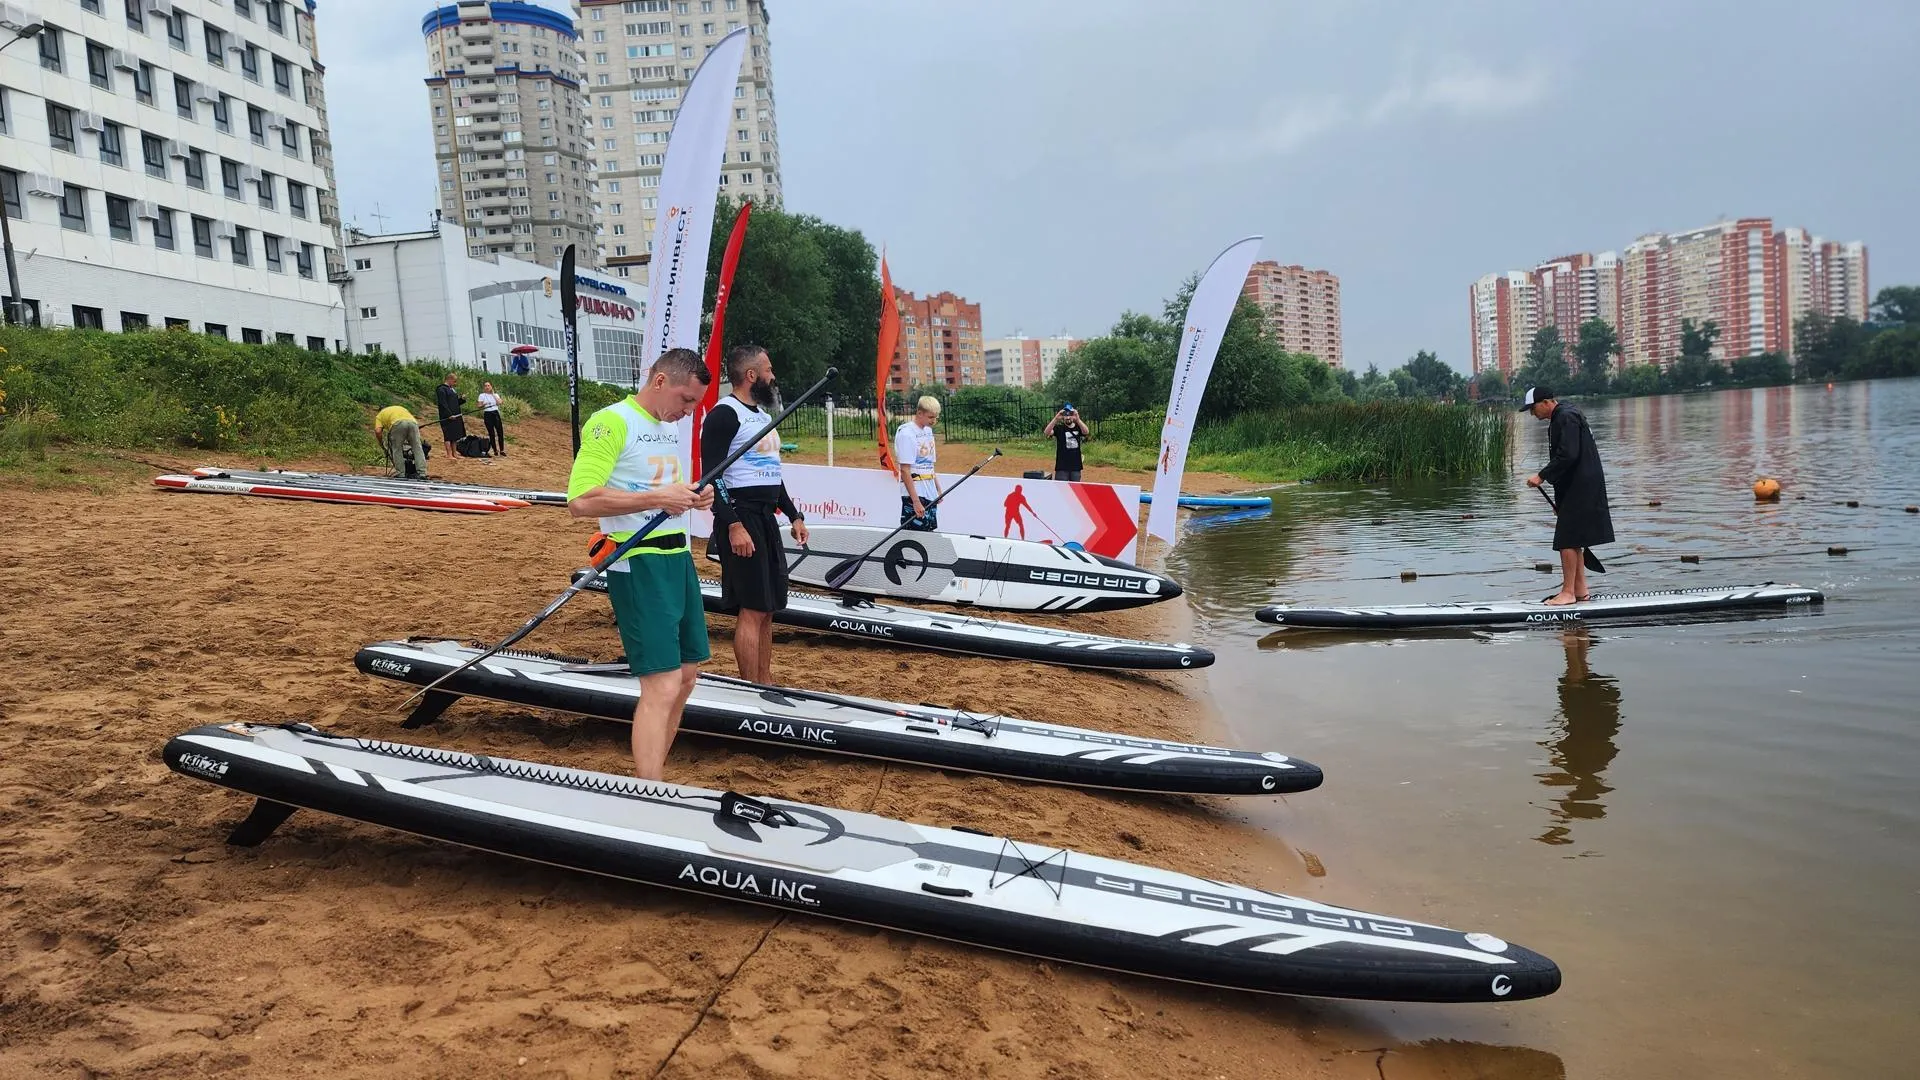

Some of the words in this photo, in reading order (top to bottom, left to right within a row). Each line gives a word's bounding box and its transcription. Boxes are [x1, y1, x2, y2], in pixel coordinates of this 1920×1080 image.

[576, 295, 635, 322] УШКИНО
[1174, 328, 1202, 416] ПРОФИ-ИНВЕСТ
[636, 434, 661, 444] AQUA
[1029, 570, 1100, 586] RIDER
[1103, 577, 1142, 590] AIR
[829, 619, 867, 632] AQUA
[1526, 613, 1560, 622] AQUA
[737, 718, 795, 737] AQUA
[802, 726, 837, 743] INC.
[678, 863, 761, 893] AQUA
[770, 878, 821, 904] INC.
[1094, 875, 1294, 920] RIDER
[1306, 911, 1415, 938] AIR
